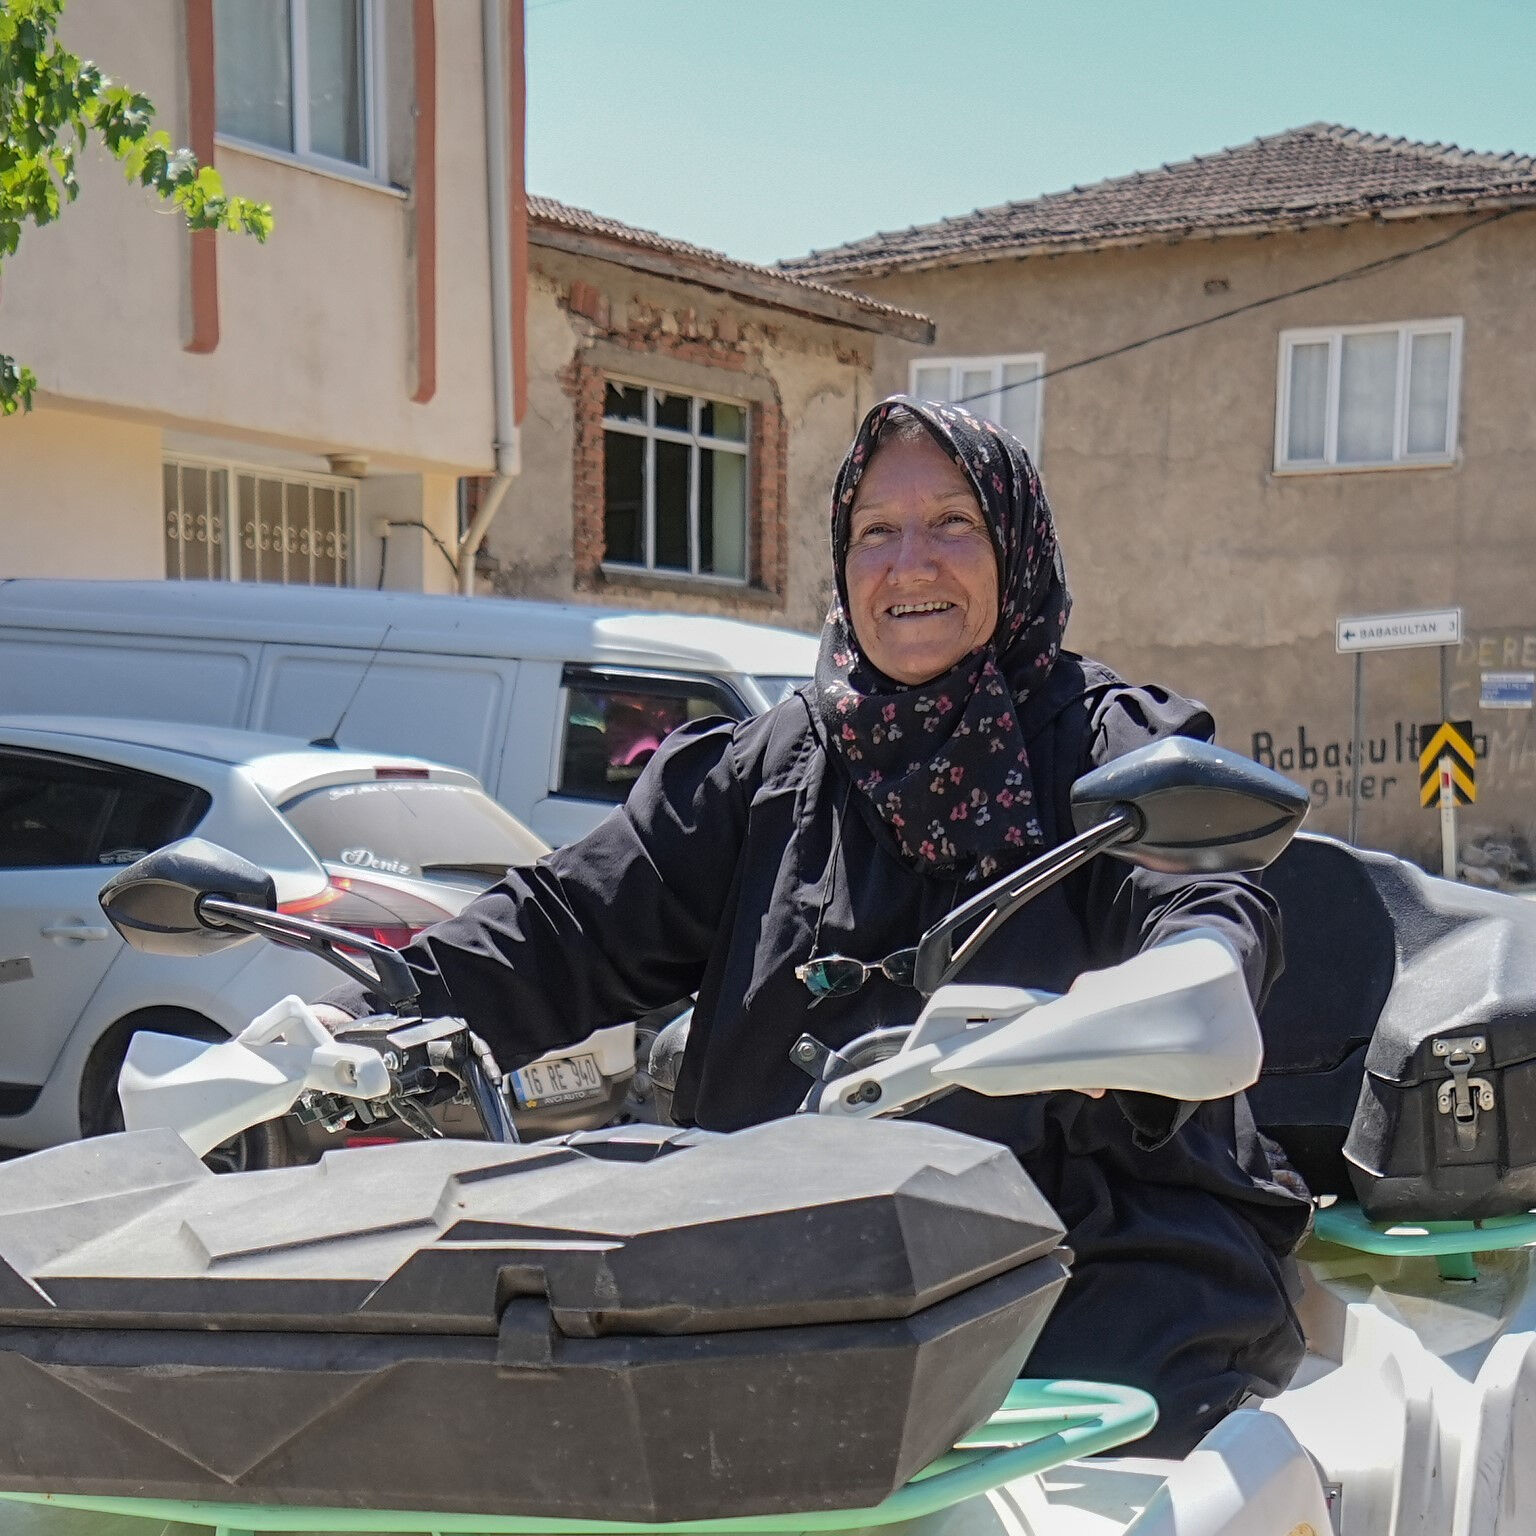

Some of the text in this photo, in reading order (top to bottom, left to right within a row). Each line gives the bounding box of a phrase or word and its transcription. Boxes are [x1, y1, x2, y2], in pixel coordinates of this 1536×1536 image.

[1359, 622, 1437, 639] BABASULTAN
[340, 849, 411, 875] Deniz
[524, 1058, 596, 1096] 16 RE 940
